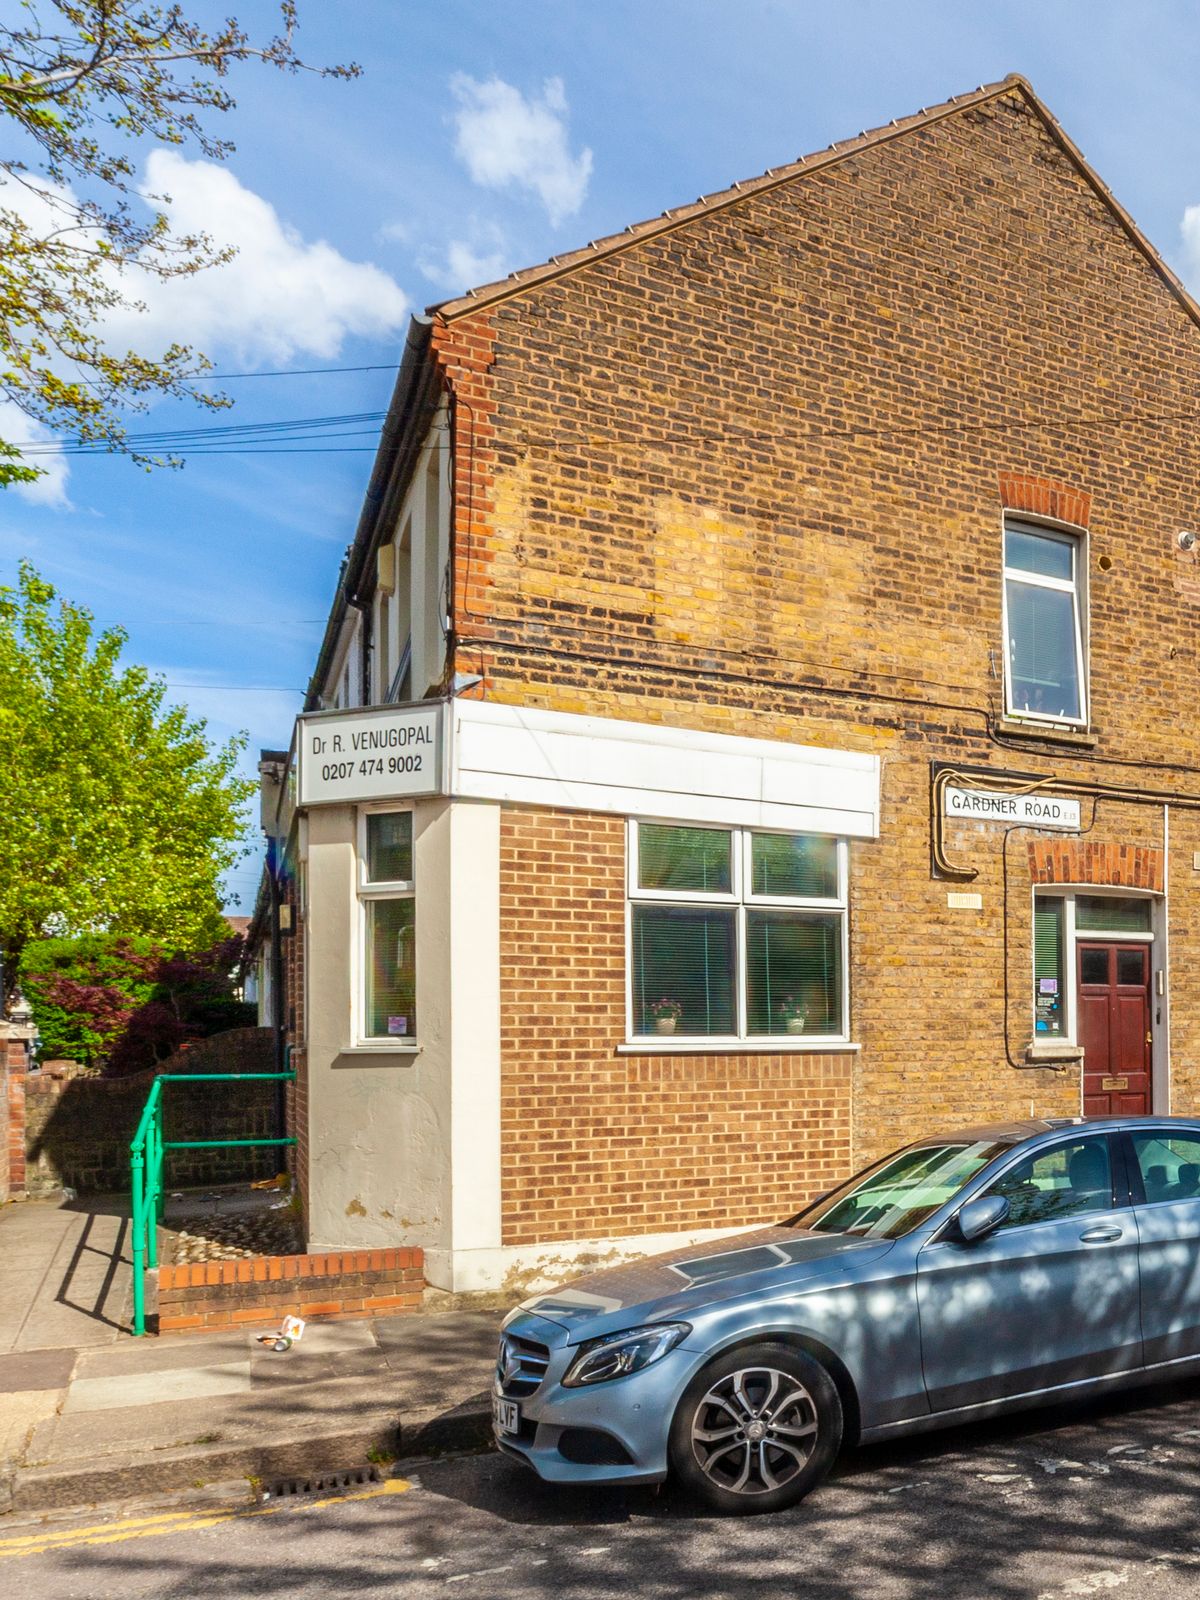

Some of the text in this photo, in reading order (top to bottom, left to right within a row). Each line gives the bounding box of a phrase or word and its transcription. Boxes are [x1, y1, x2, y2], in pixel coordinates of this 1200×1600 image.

[313, 725, 433, 754] Dr R. VENUGOPAL
[322, 755, 422, 781] 0207 474 9002
[952, 795, 1061, 818] GARDNER ROAD
